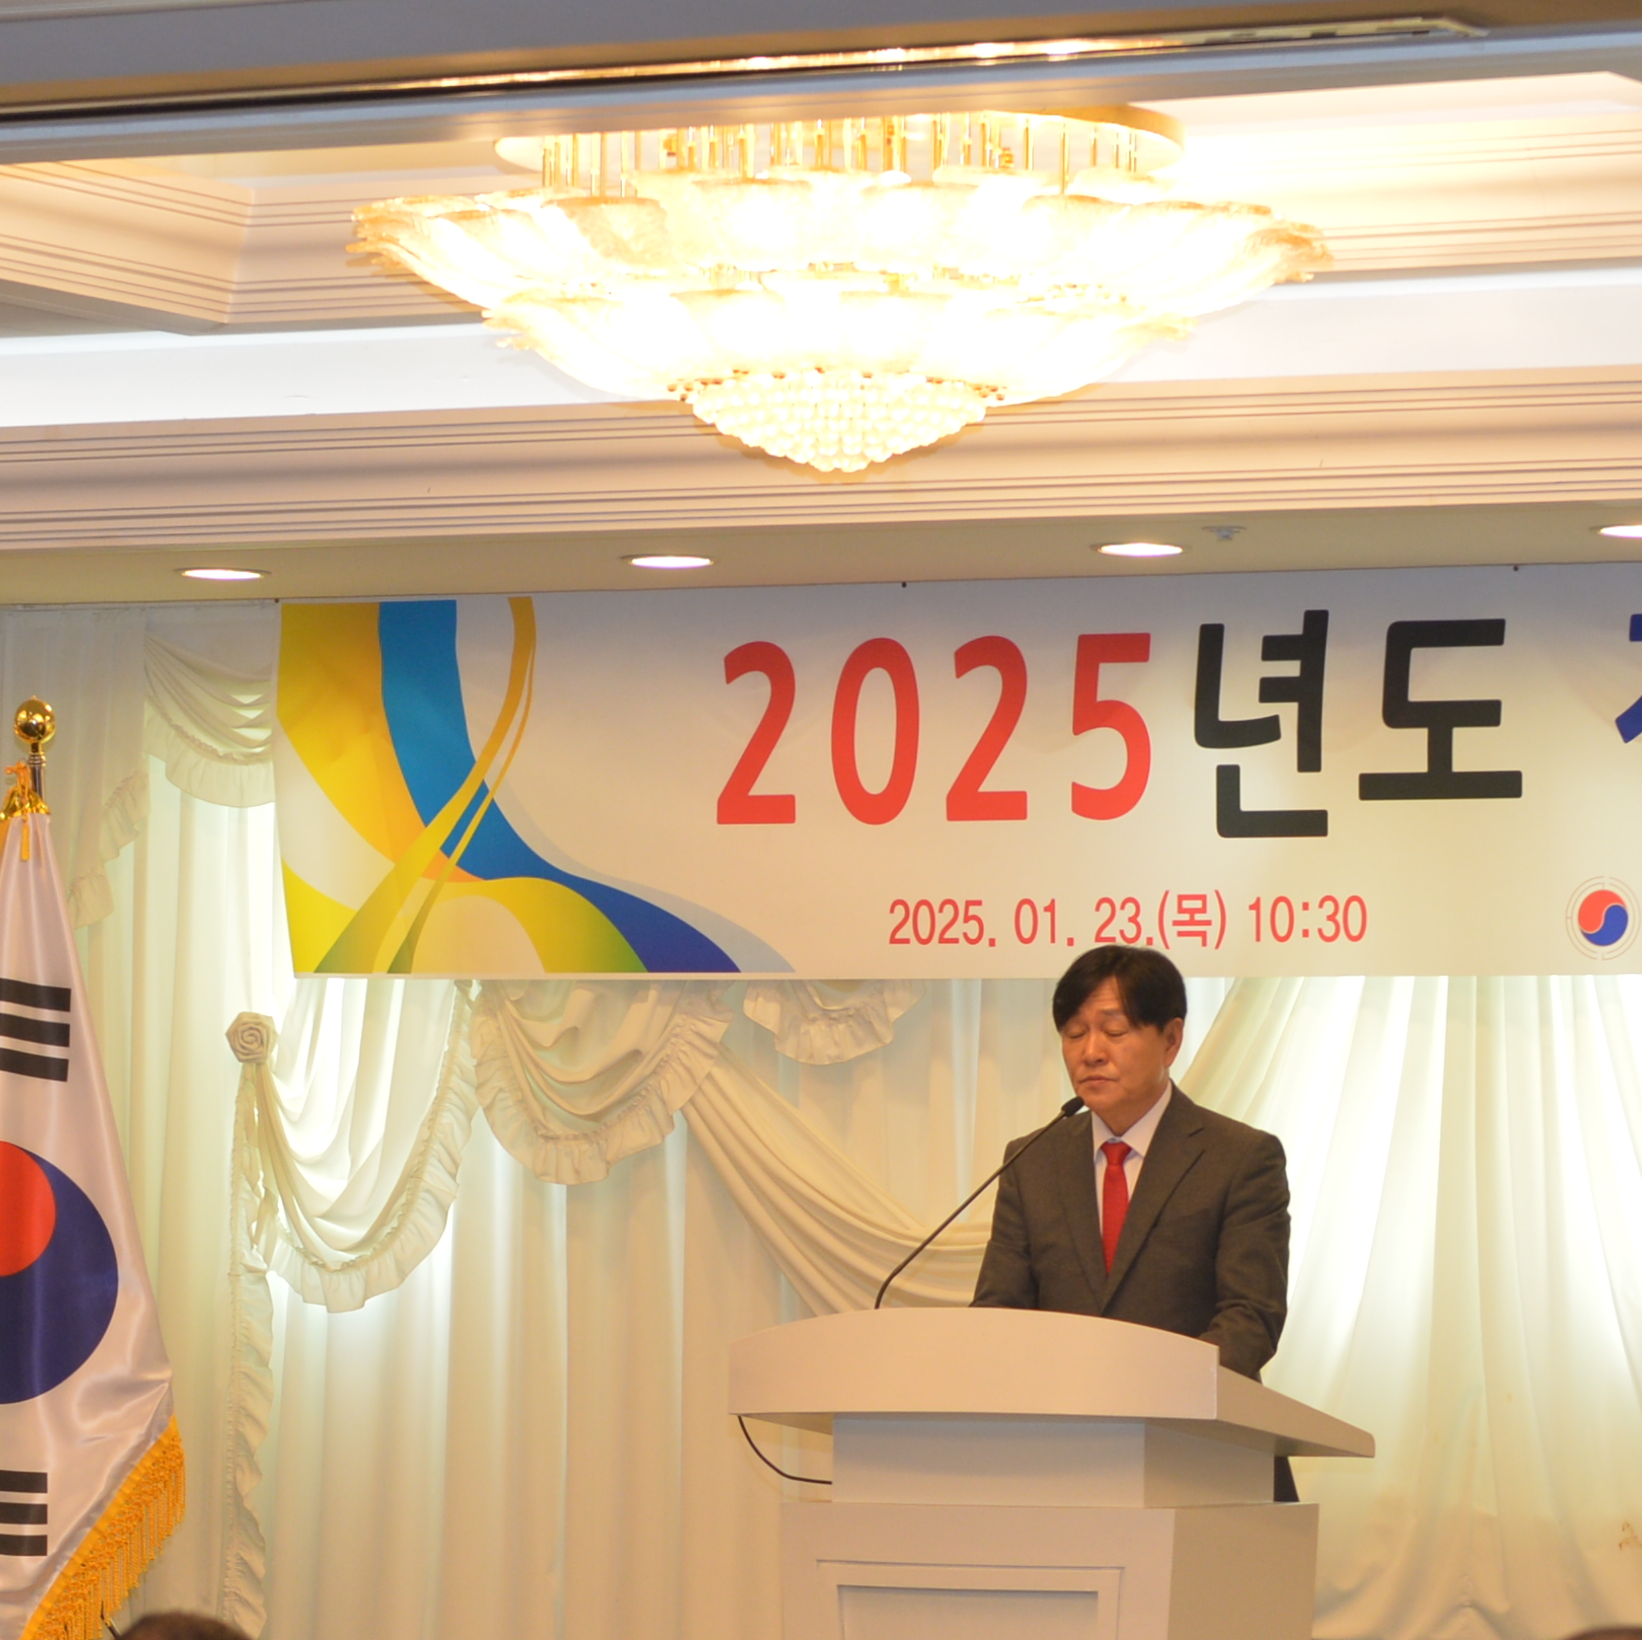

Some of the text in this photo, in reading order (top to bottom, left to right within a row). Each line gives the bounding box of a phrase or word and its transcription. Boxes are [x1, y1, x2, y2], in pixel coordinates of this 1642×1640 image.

[715, 608, 1524, 838] 2025년도
[887, 896, 998, 948] 2025.
[1013, 896, 1076, 948] 01.
[1248, 893, 1369, 945] 10:30
